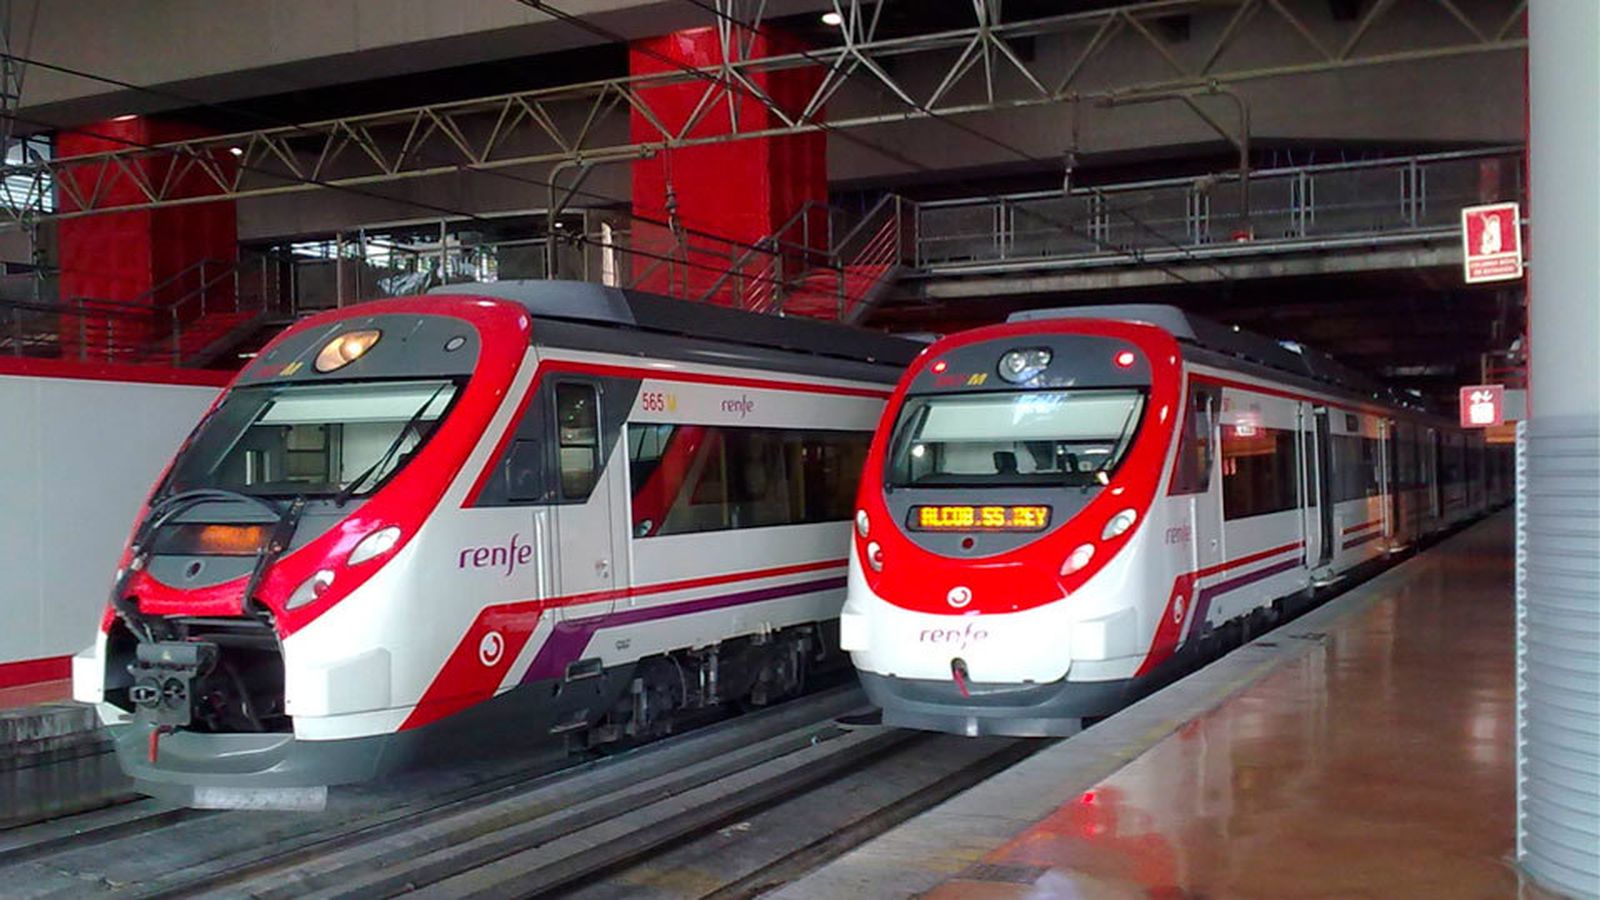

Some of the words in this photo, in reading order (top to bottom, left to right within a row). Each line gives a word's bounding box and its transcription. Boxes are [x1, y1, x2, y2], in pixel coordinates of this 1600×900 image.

[721, 395, 755, 417] renfe
[459, 533, 532, 576] renfe
[919, 622, 988, 650] renfe
